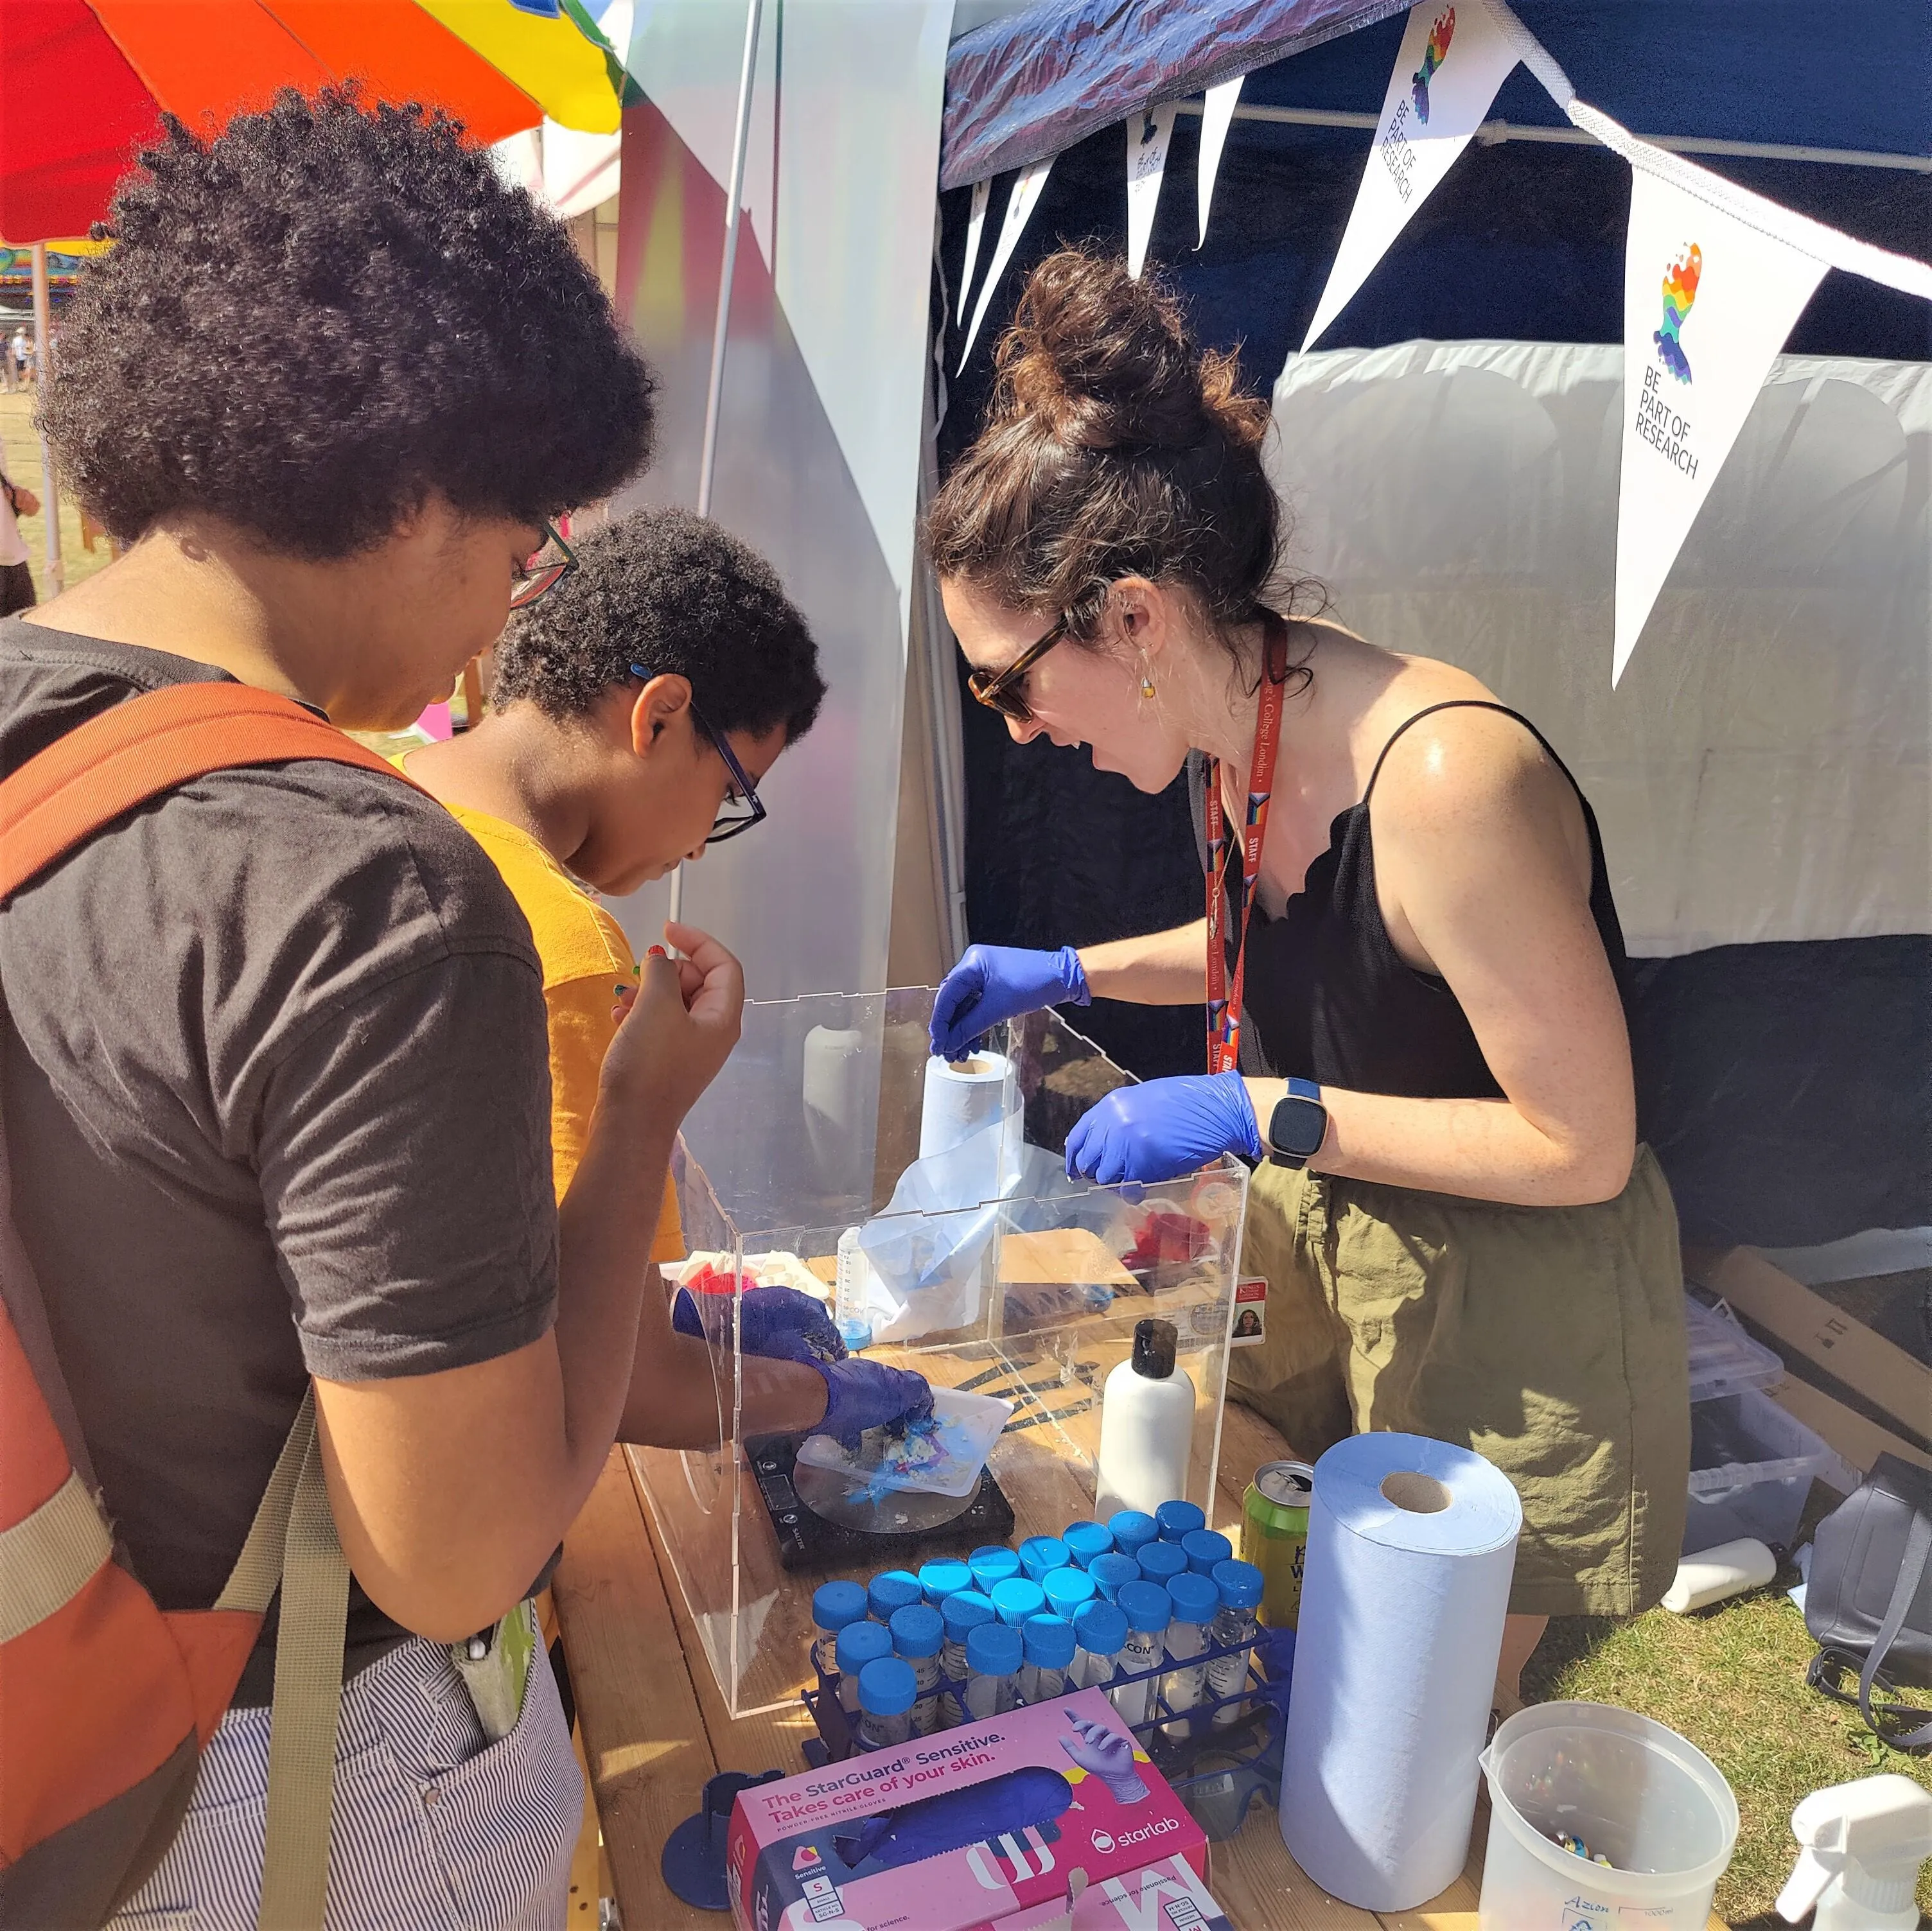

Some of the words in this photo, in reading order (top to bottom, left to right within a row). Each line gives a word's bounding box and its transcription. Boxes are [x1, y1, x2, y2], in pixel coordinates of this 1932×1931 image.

[1396, 99, 1410, 125] BE
[1388, 118, 1408, 155] PART
[1403, 148, 1416, 171] OF
[1380, 136, 1413, 204] RESEARCH
[1644, 365, 1662, 394] BE
[1640, 389, 1672, 428] PART
[1671, 415, 1690, 442] OF
[1635, 412, 1699, 480] RESEARCH
[1260, 703, 1274, 740] College
[1256, 742, 1270, 776] London
[1209, 800, 1218, 826] STAFF
[1248, 837, 1260, 863] STAFF
[1222, 1054, 1233, 1072] STA
[792, 1528, 805, 1550] SALTER
[1125, 1643, 1155, 1655] CON
[762, 1792, 802, 1809] The
[915, 1734, 1006, 1765] Sensitive.
[768, 1799, 828, 1823] Takes
[832, 1787, 875, 1805] care
[879, 1776, 898, 1792] of
[902, 1766, 945, 1789] your
[950, 1753, 996, 1772] skin.
[777, 1820, 807, 1832] POWDER
[830, 1806, 858, 1817] NITRILE
[859, 1799, 886, 1809] GLOVES
[1118, 1817, 1179, 1847] starlab
[794, 1865, 827, 1880] Sensitive
[1140, 1875, 1177, 1892] Passionate
[813, 1883, 823, 1892] S
[1099, 1892, 1128, 1907] science.
[1128, 1888, 1139, 1896] for
[814, 1905, 832, 1914] ARTICLE
[879, 1914, 910, 1928] science.
